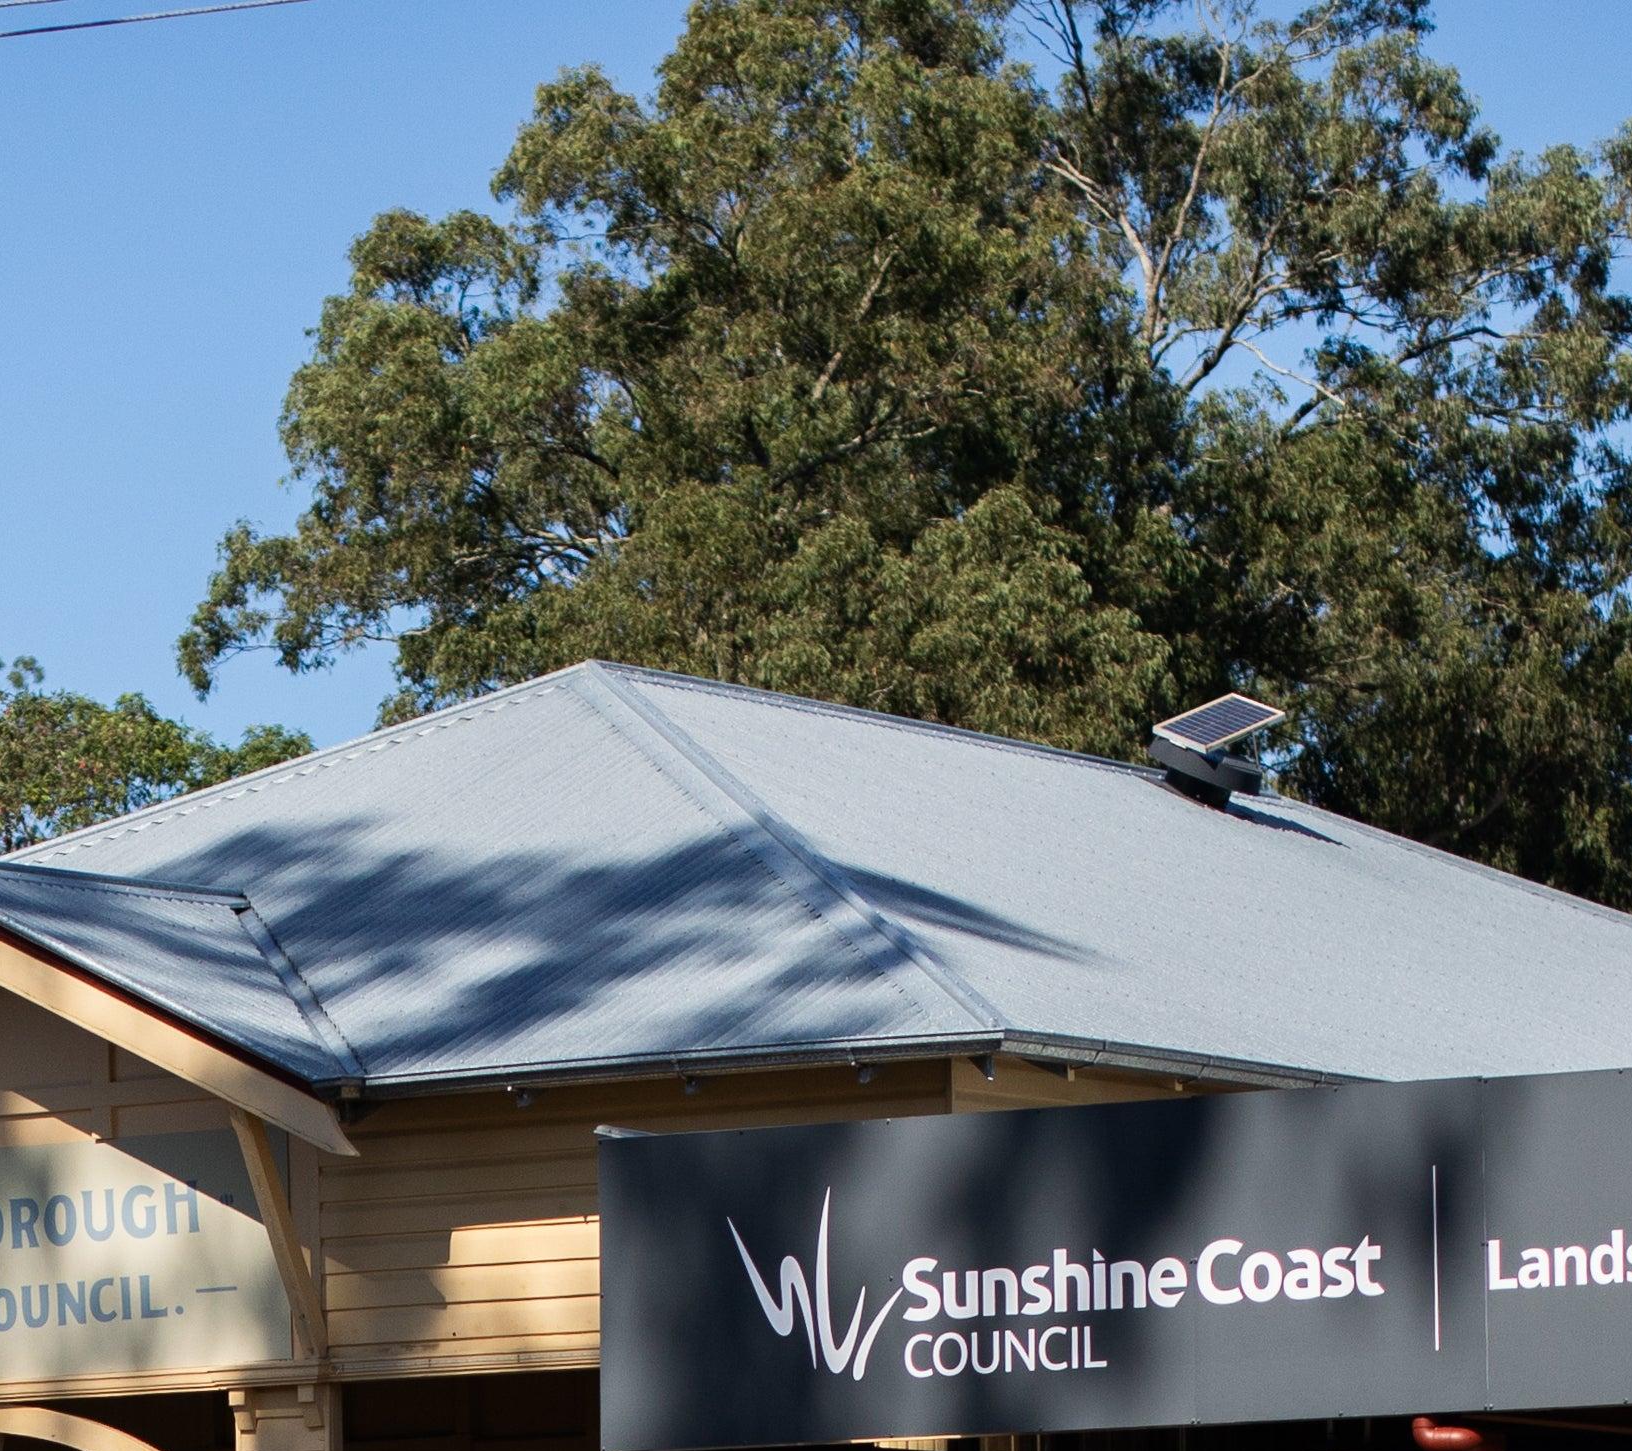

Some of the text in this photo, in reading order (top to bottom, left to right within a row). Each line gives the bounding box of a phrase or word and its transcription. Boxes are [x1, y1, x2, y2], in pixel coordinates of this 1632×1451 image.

[902, 1234, 1385, 1322] Sunshine Coast
[904, 1326, 1108, 1379] COUNCIL
